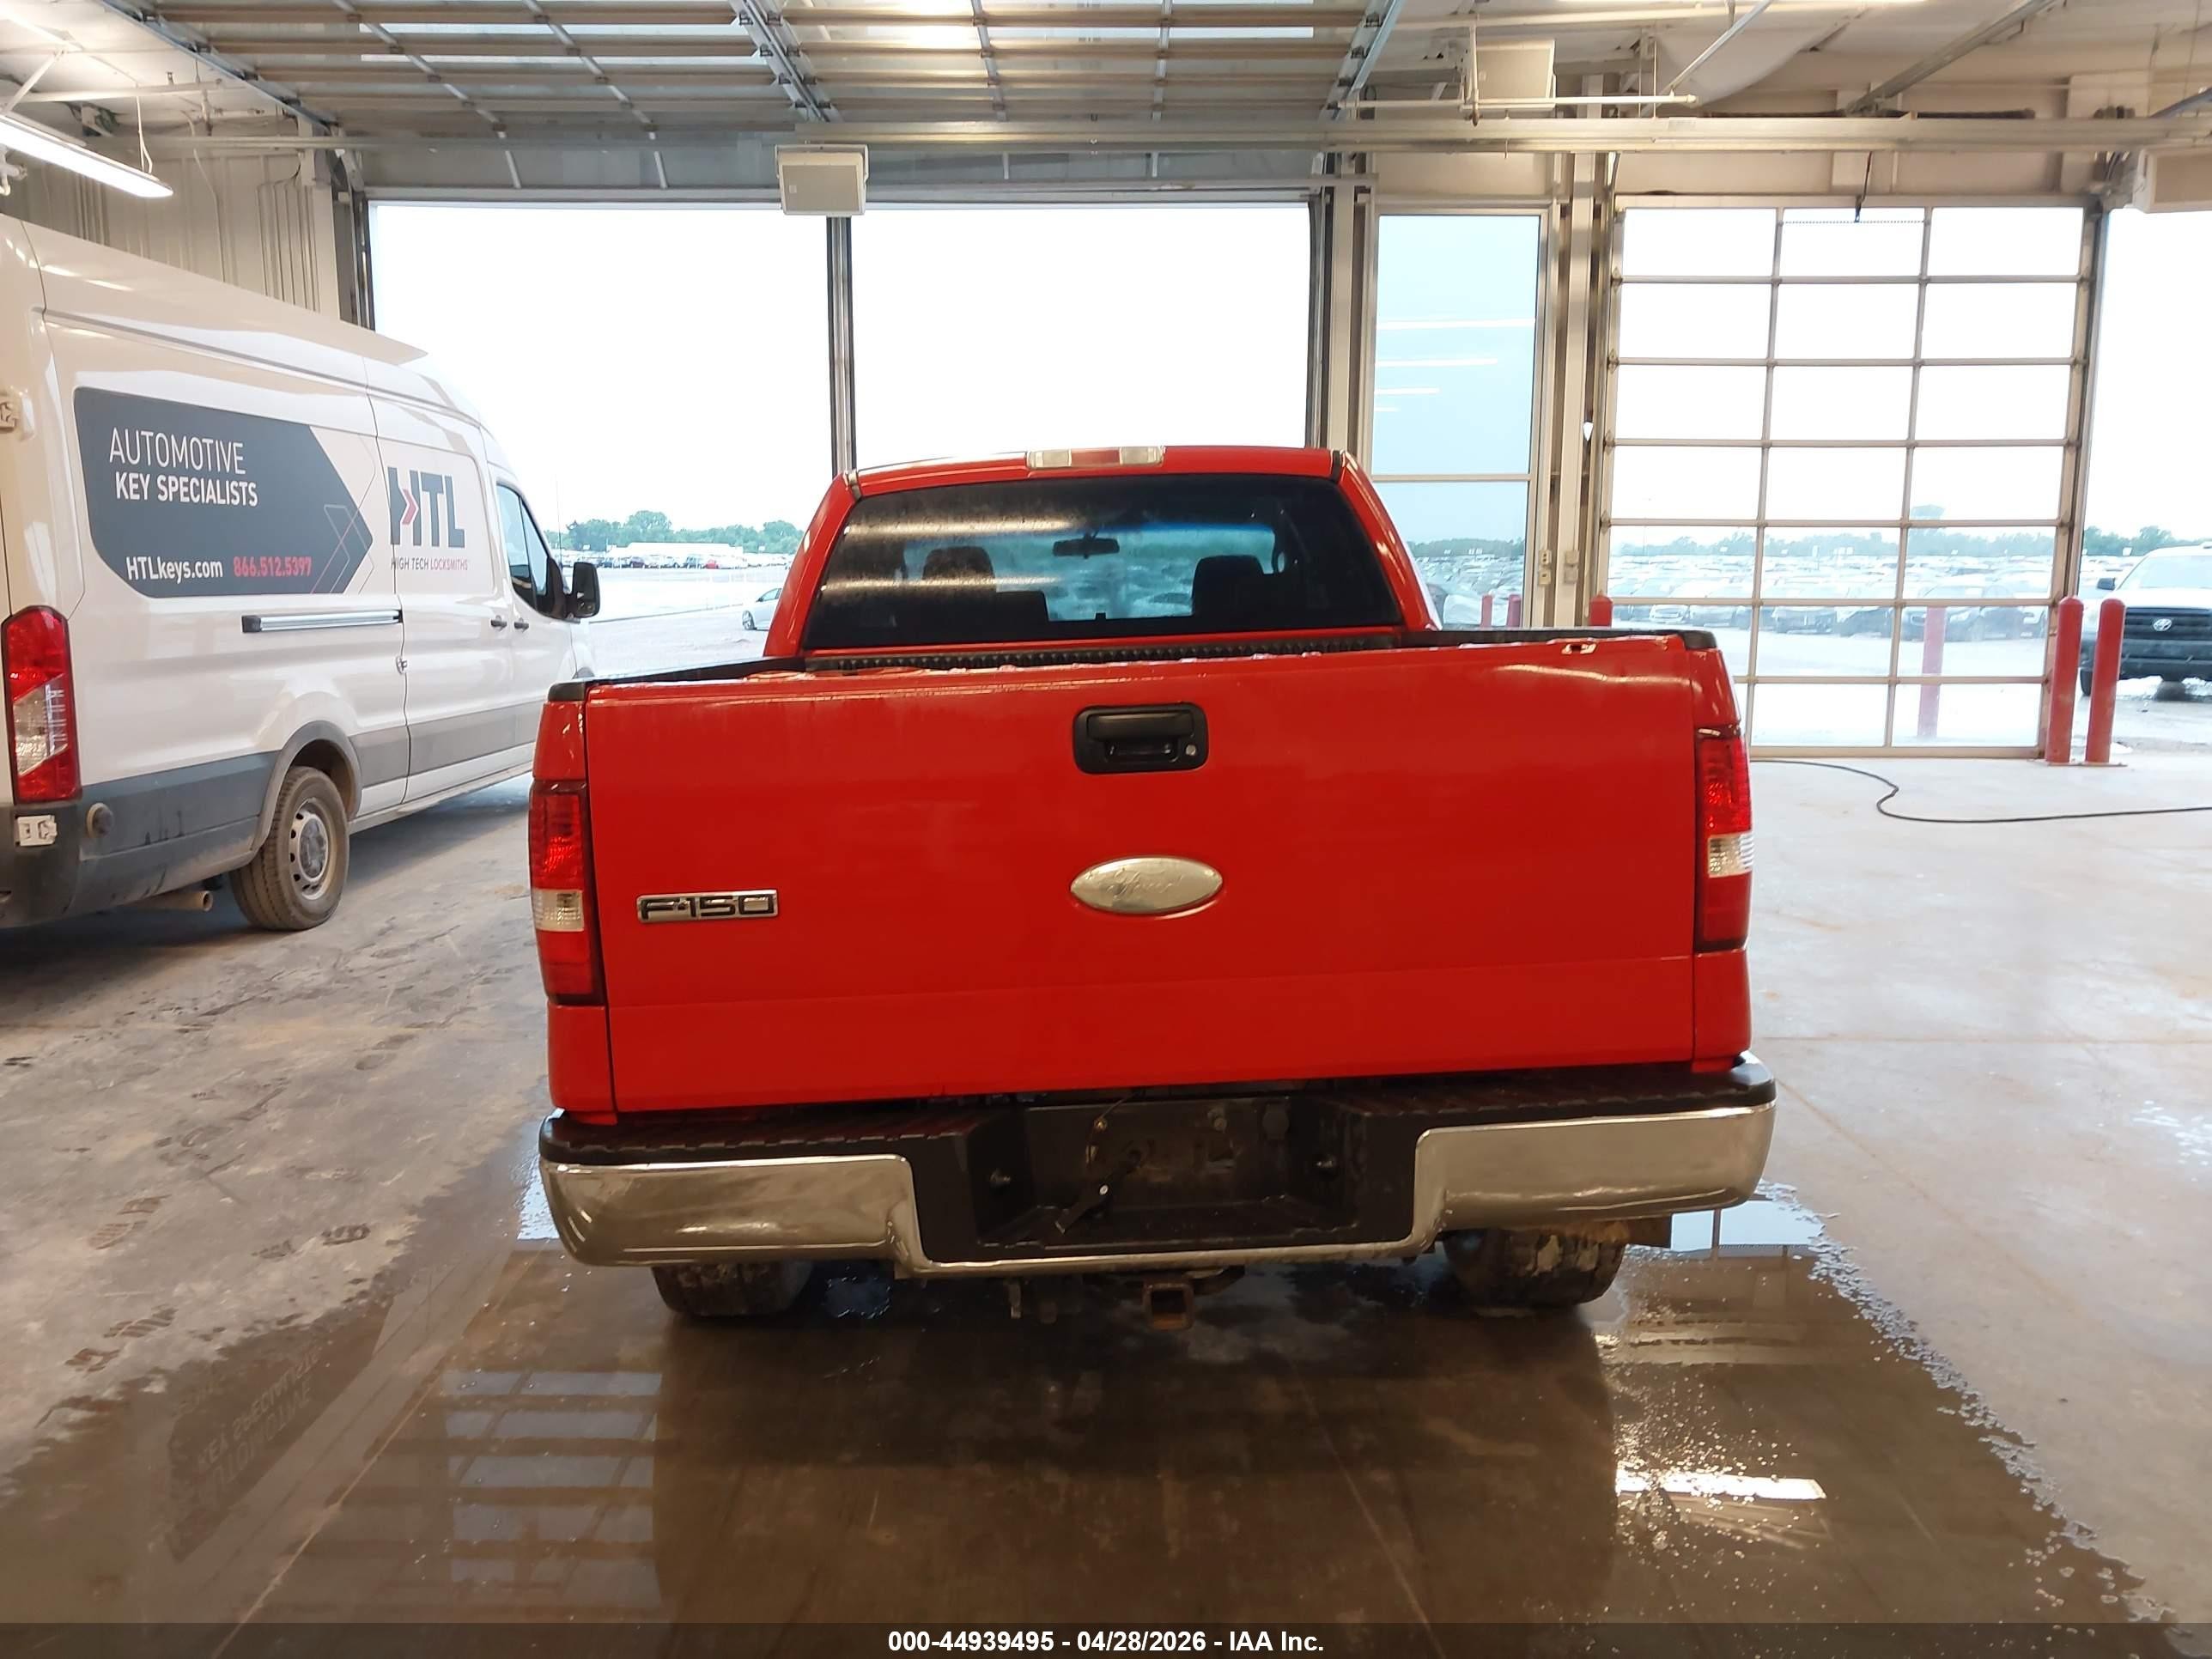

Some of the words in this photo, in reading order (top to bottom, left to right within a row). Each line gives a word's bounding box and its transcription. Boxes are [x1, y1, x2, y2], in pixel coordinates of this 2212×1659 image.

[109, 427, 246, 475] AUTOMOTIVE
[115, 471, 151, 501] KEY
[156, 474, 258, 507] SPECIALISTS
[387, 466, 465, 549] HTL
[126, 556, 224, 584] HTLkeys.com
[233, 556, 313, 578] 866.512.5397
[391, 556, 410, 571] HIGH
[411, 557, 429, 570] TECH
[430, 557, 468, 571] LOCKSMITHS
